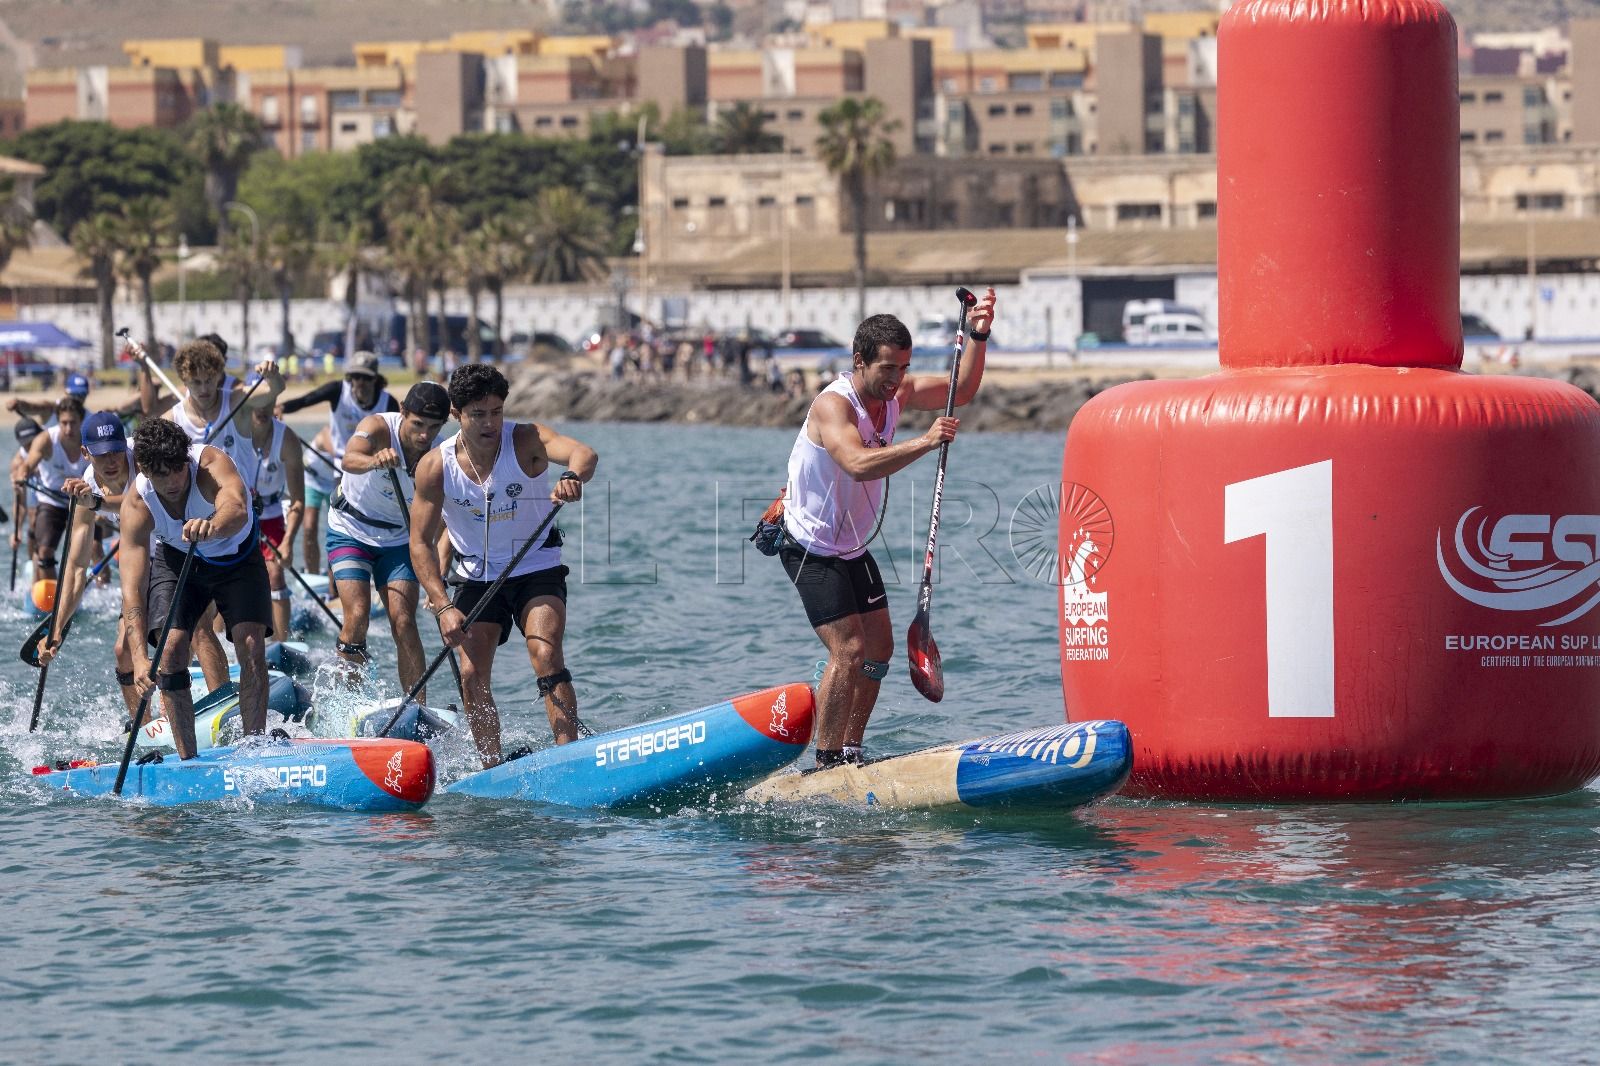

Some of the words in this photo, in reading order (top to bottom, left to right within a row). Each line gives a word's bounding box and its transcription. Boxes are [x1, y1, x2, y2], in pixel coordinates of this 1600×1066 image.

[96, 424, 115, 438] NSP
[1224, 459, 1335, 717] 1
[1065, 601, 1106, 617] EUROPEAN
[1065, 626, 1108, 646] SURFING
[1445, 635, 1555, 650] EUROPEAN
[1561, 635, 1589, 650] SUP
[1066, 647, 1109, 661] FEDERATION
[1481, 655, 1520, 667] CERTIFFIED
[1522, 655, 1531, 667] BY
[1533, 655, 1545, 667] THE
[1546, 655, 1574, 667] EUROPEAN
[595, 720, 706, 767] STARBOARD
